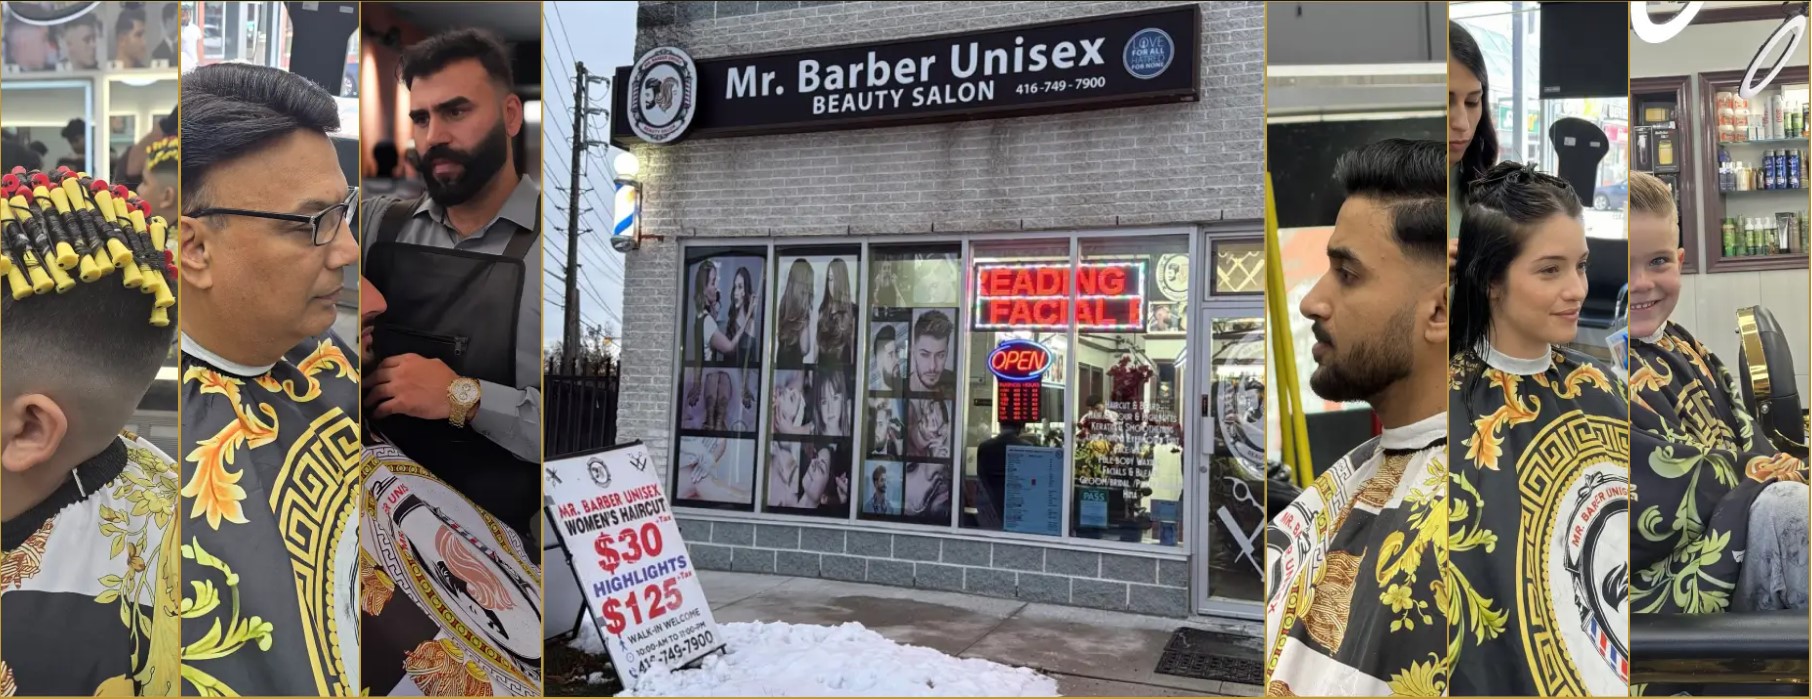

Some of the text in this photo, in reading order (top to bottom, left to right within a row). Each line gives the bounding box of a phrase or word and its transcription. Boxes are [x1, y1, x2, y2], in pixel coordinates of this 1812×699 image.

[725, 36, 1106, 99] Mr. Barber Unisex
[812, 80, 994, 115] BEAUTY SALON
[989, 299, 1117, 325] FACIAL
[992, 350, 1046, 370] OPEN
[558, 483, 662, 519] MR. BARBER UNISEX
[1083, 492, 1105, 500] PASS
[564, 498, 666, 536] WOMEN'S HAIRCUT
[1280, 511, 1294, 530] MR.
[594, 522, 663, 575] $30
[1572, 525, 1585, 548] MR.
[593, 555, 687, 598] HIGHLIGHTS
[602, 577, 683, 639] $125
[628, 607, 700, 644] WALK-IN WELCOME
[668, 633, 679, 642] TO
